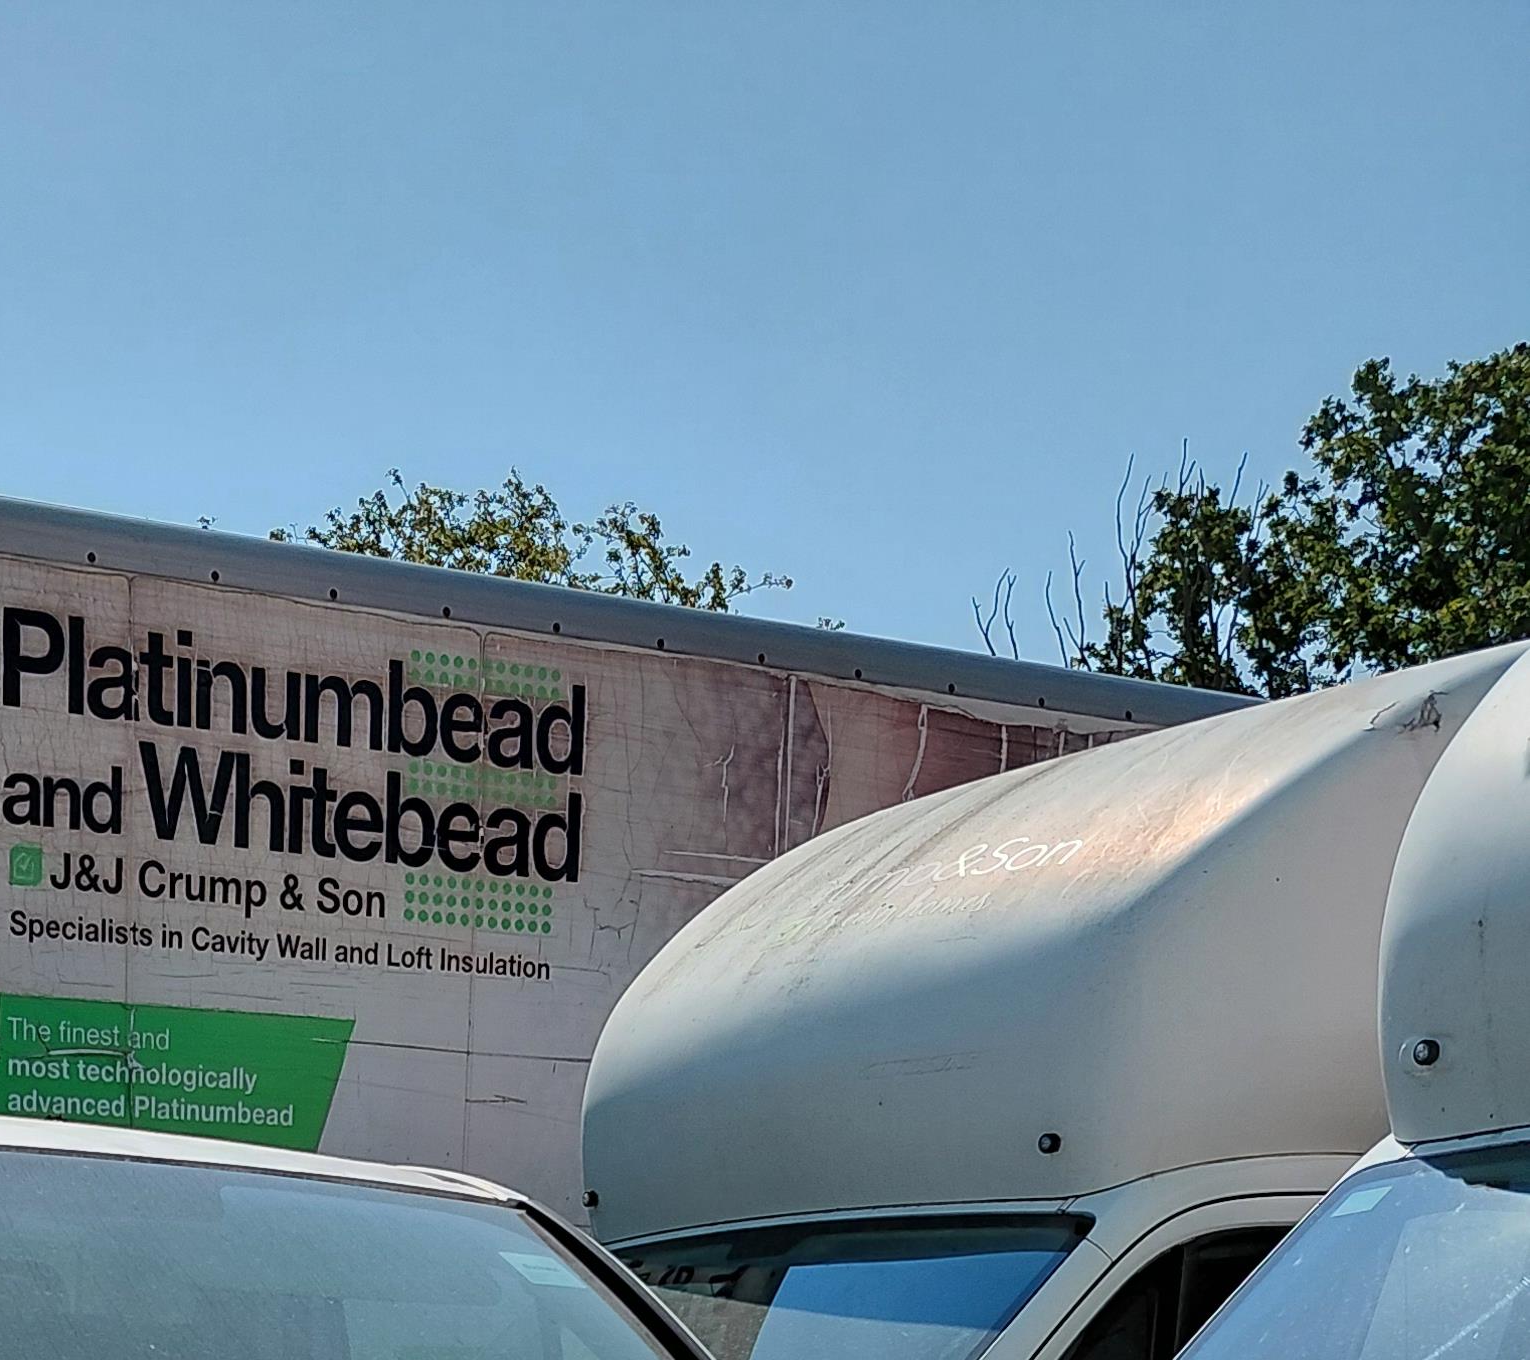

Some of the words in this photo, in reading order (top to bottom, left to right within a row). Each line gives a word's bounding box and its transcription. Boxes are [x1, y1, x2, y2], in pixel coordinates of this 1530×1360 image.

[2, 606, 586, 776] Platinumbead
[2, 766, 122, 834] and
[139, 740, 581, 882] Whitebead
[50, 851, 124, 896] J&J
[137, 858, 268, 919] Crump
[278, 873, 306, 911] &
[315, 876, 386, 919] Son
[9, 910, 153, 949] Specialists
[161, 922, 183, 950] in
[191, 924, 270, 961] Cavity
[276, 933, 327, 963] Wall
[334, 937, 379, 966] and
[387, 944, 433, 972] Loft
[440, 947, 551, 981] Insulation
[8, 1016, 52, 1044] The
[58, 1020, 120, 1048] finest
[127, 1024, 170, 1051] and
[7, 1055, 70, 1082] most
[76, 1056, 258, 1096] technologically
[7, 1089, 125, 1119] advanced
[133, 1094, 295, 1128] Platinumbead
